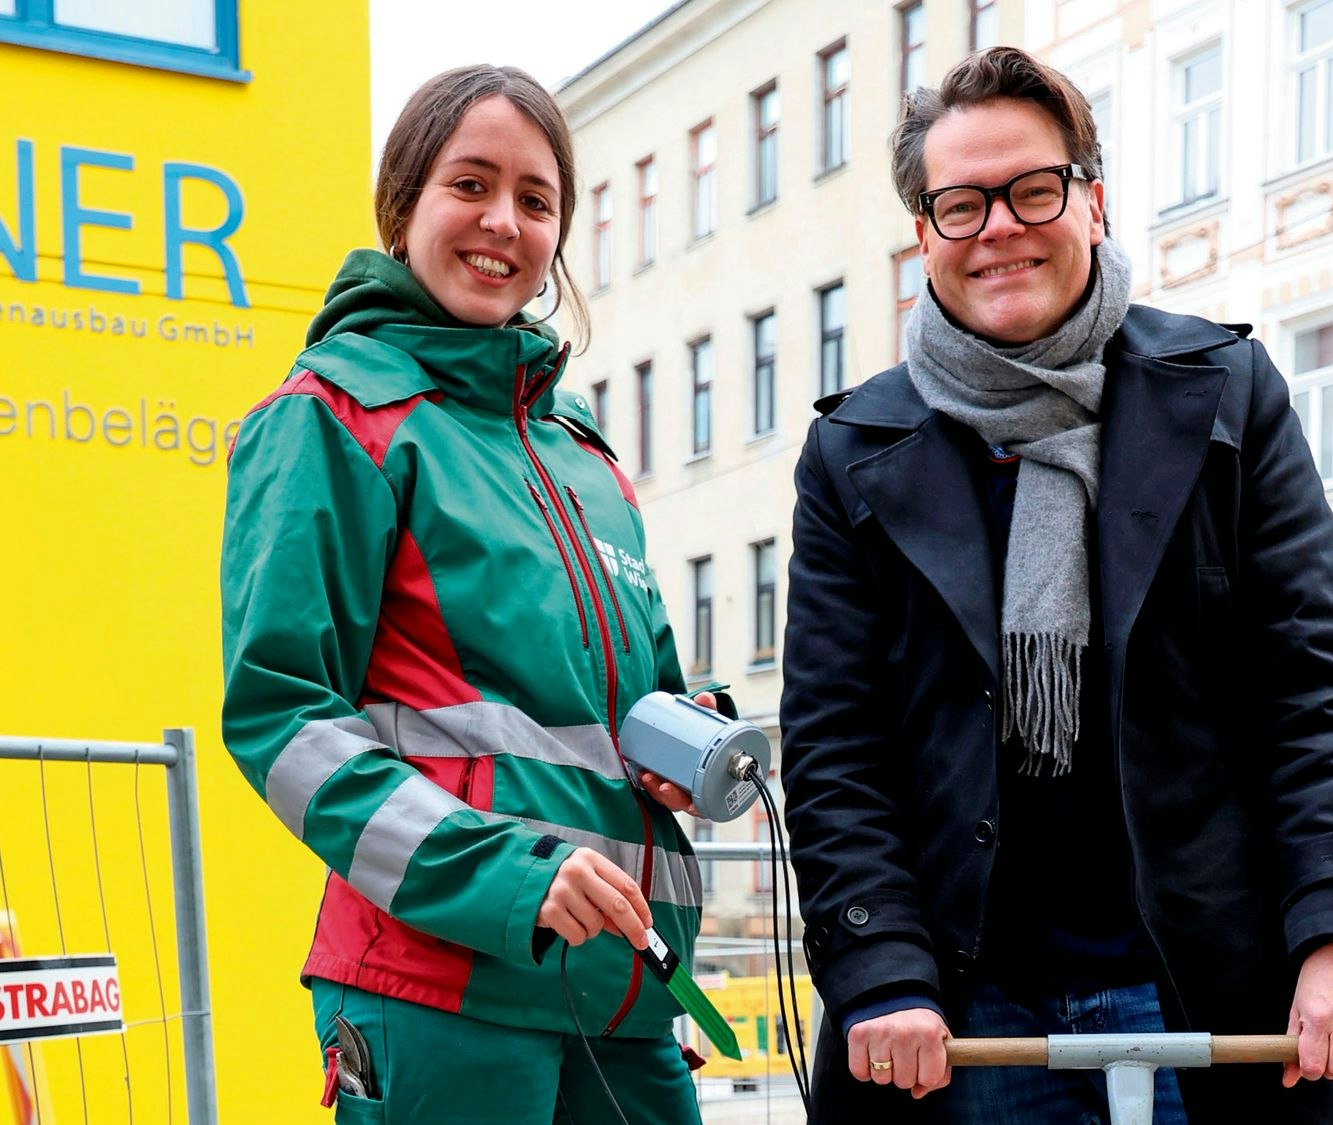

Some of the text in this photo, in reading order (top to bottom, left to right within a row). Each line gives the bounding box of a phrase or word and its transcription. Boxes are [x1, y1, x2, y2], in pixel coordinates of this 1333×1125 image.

[0, 303, 254, 348] nausbau GmbH
[0, 977, 120, 1020] TRABAG
